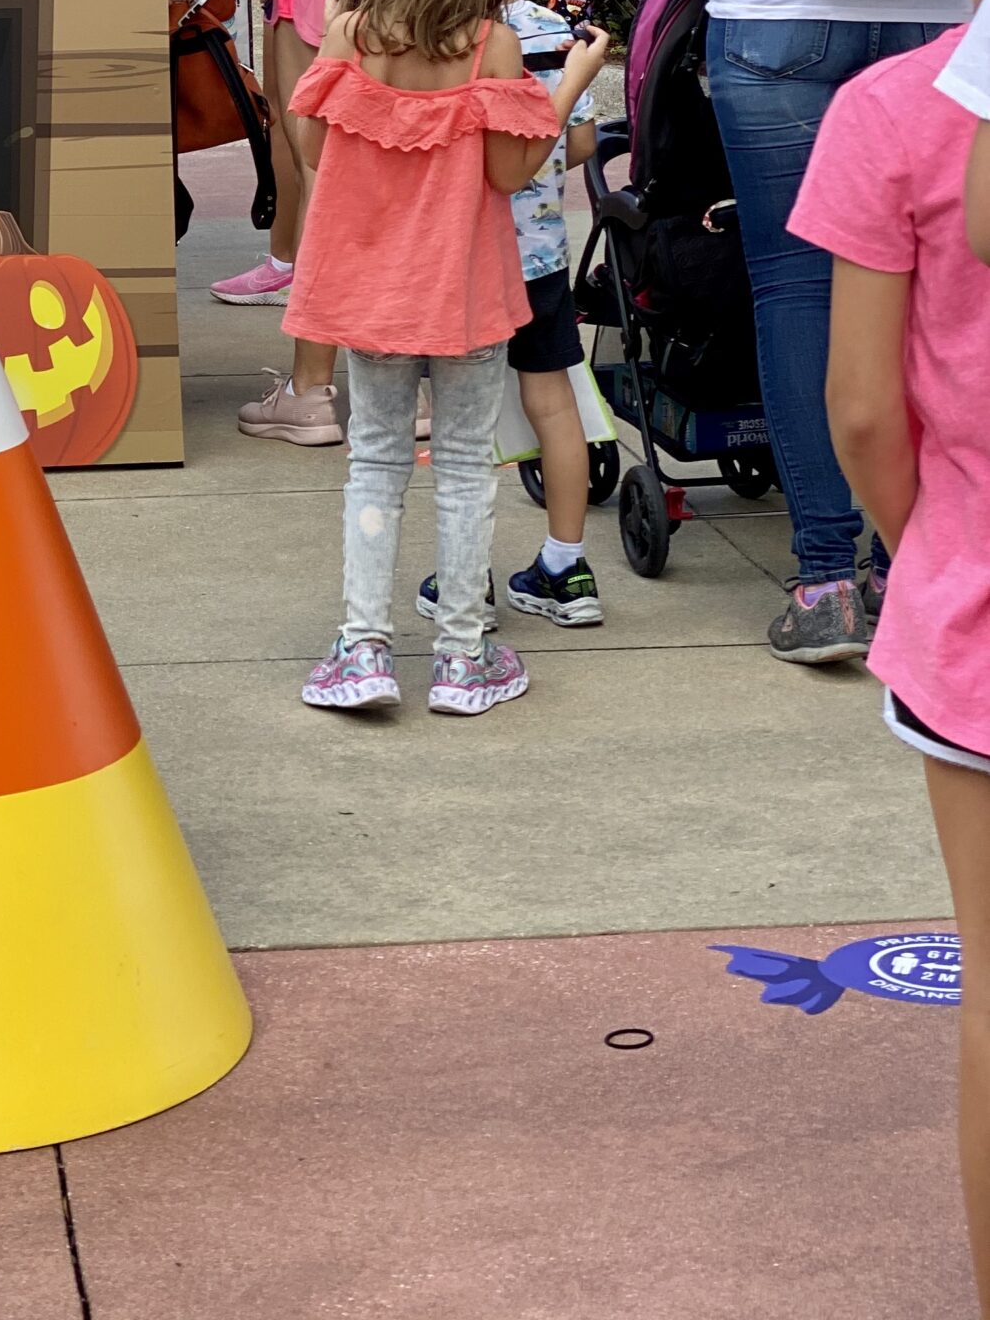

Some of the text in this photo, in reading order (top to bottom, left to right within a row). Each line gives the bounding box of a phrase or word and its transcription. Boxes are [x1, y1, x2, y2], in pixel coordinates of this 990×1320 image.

[728, 433, 770, 447] World
[874, 936, 961, 947] PRACTIC
[926, 950, 941, 959] 6
[920, 971, 957, 983] 2 M
[867, 979, 961, 1000] DISTANC
